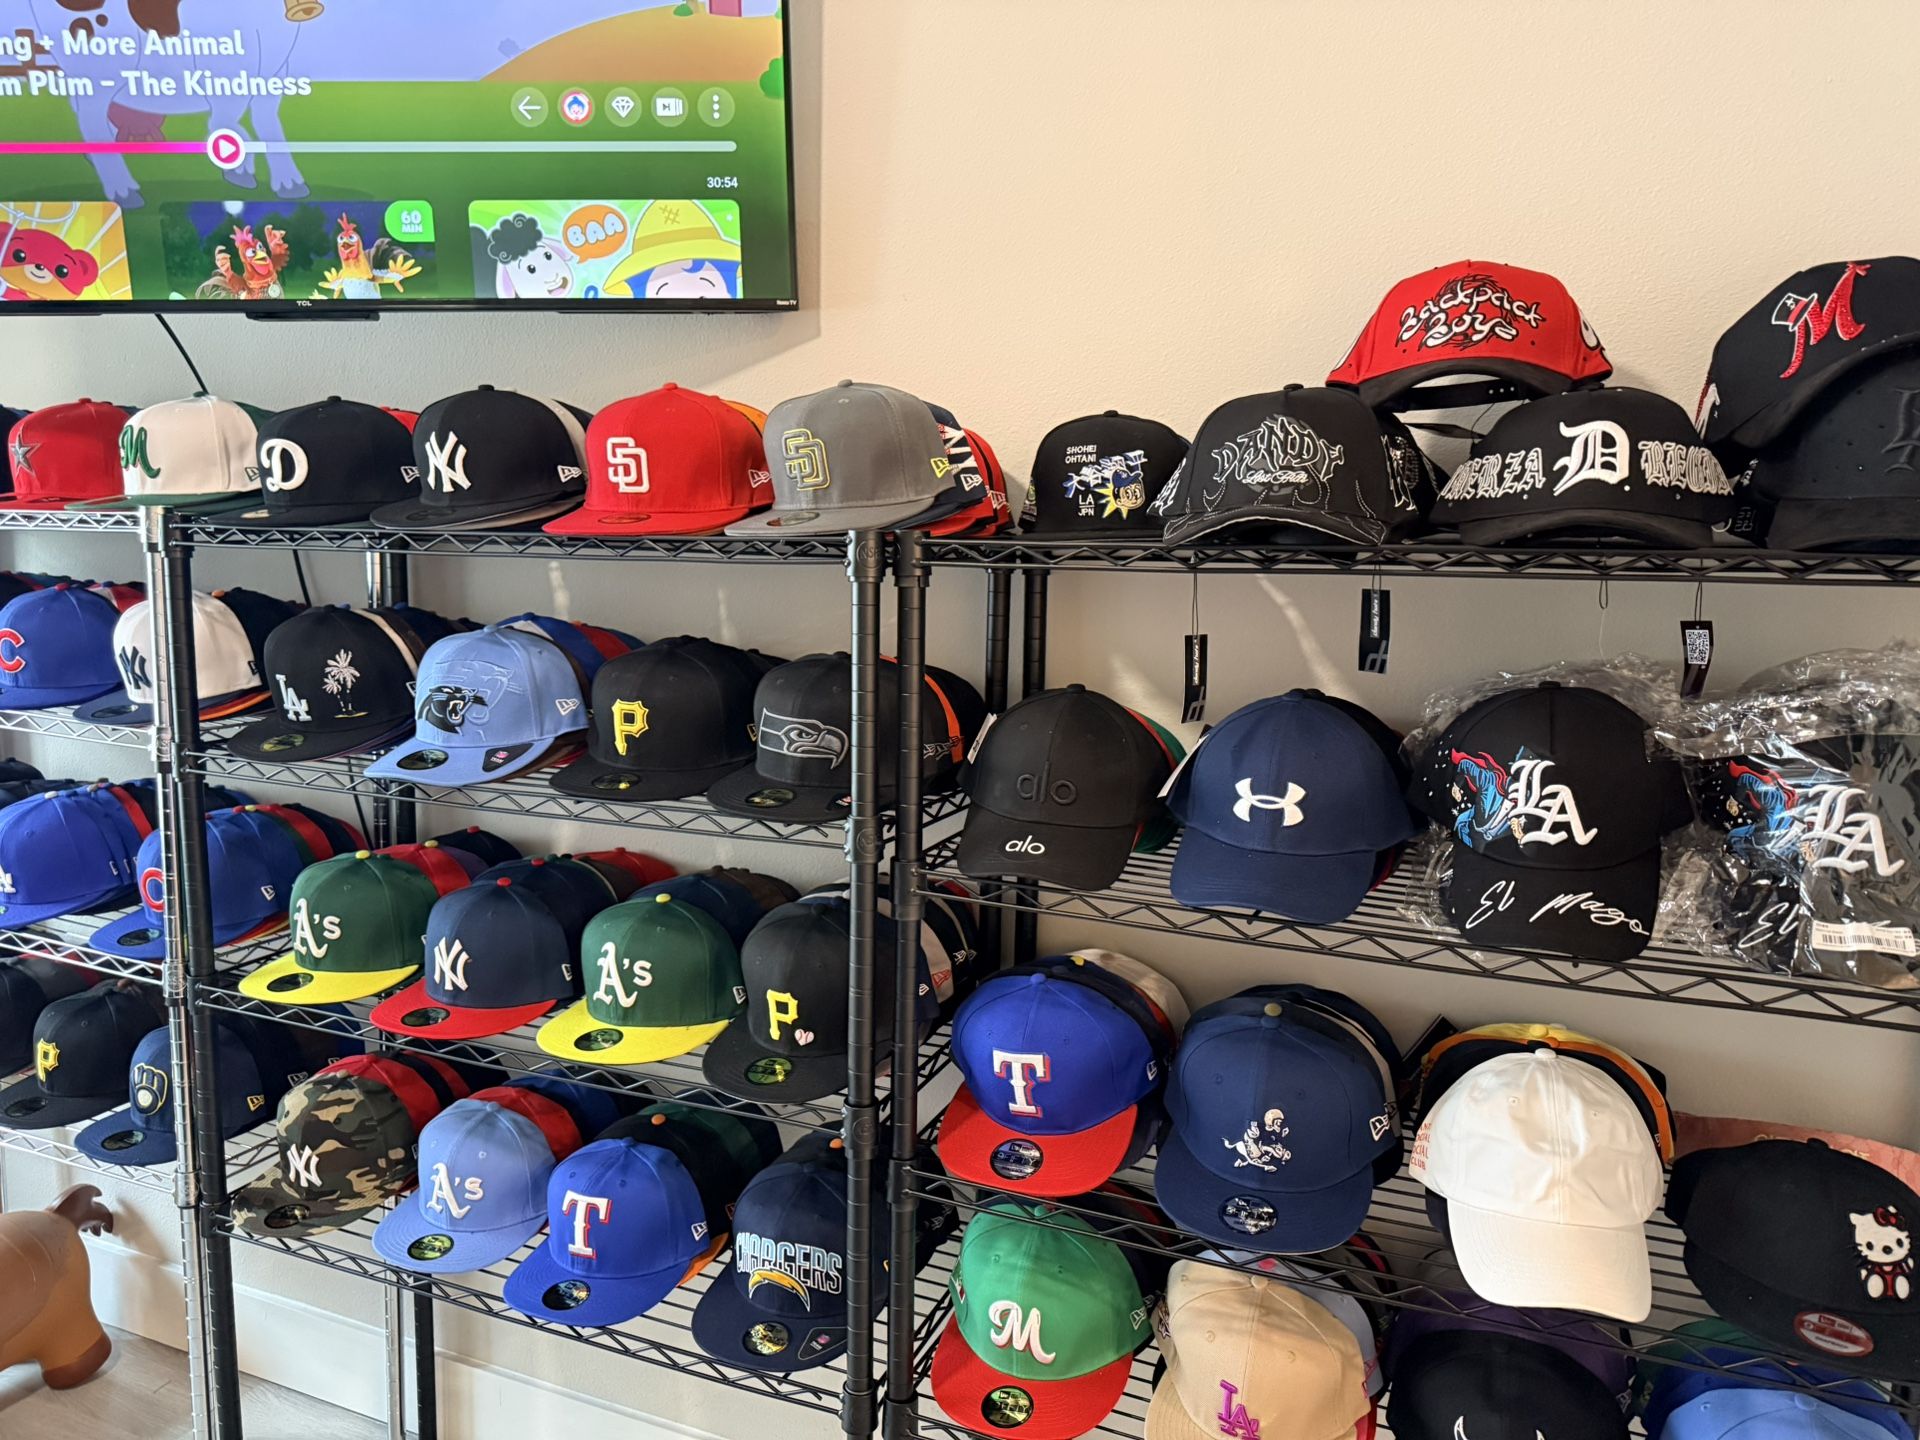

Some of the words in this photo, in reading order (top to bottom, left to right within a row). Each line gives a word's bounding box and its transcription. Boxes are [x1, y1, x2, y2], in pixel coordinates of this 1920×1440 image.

[61, 29, 136, 56] More
[144, 29, 245, 56] Animal
[27, 70, 93, 96] Plim
[121, 70, 176, 96] The
[183, 70, 312, 96] Kindness
[706, 176, 738, 189] 30:54
[401, 210, 422, 224] 60
[401, 223, 423, 233] MIN
[566, 213, 625, 248] BAA
[260, 438, 309, 493] D
[424, 430, 473, 492] NY
[606, 436, 651, 494] SD
[782, 428, 830, 490] SD
[1064, 453, 1097, 464] OHTANI
[1066, 444, 1097, 455] SHOHEI
[1077, 507, 1095, 516] JPN
[1078, 493, 1095, 505] LA
[274, 673, 313, 723] LA
[611, 698, 650, 756] P
[1508, 758, 1599, 847] LA
[1004, 835, 1046, 856] alo
[1801, 783, 1906, 877] LA
[293, 898, 343, 959] A's
[434, 936, 470, 992] NY
[593, 941, 654, 1009] A's
[765, 988, 799, 1041] P
[37, 1038, 61, 1083] P
[993, 1047, 1051, 1119] T
[286, 1143, 323, 1188] NY
[1410, 1156, 1427, 1170] CLUB
[427, 1162, 485, 1219] A's
[560, 1189, 613, 1260] T
[736, 1231, 843, 1294] CHARGERS
[987, 1299, 1056, 1365] M
